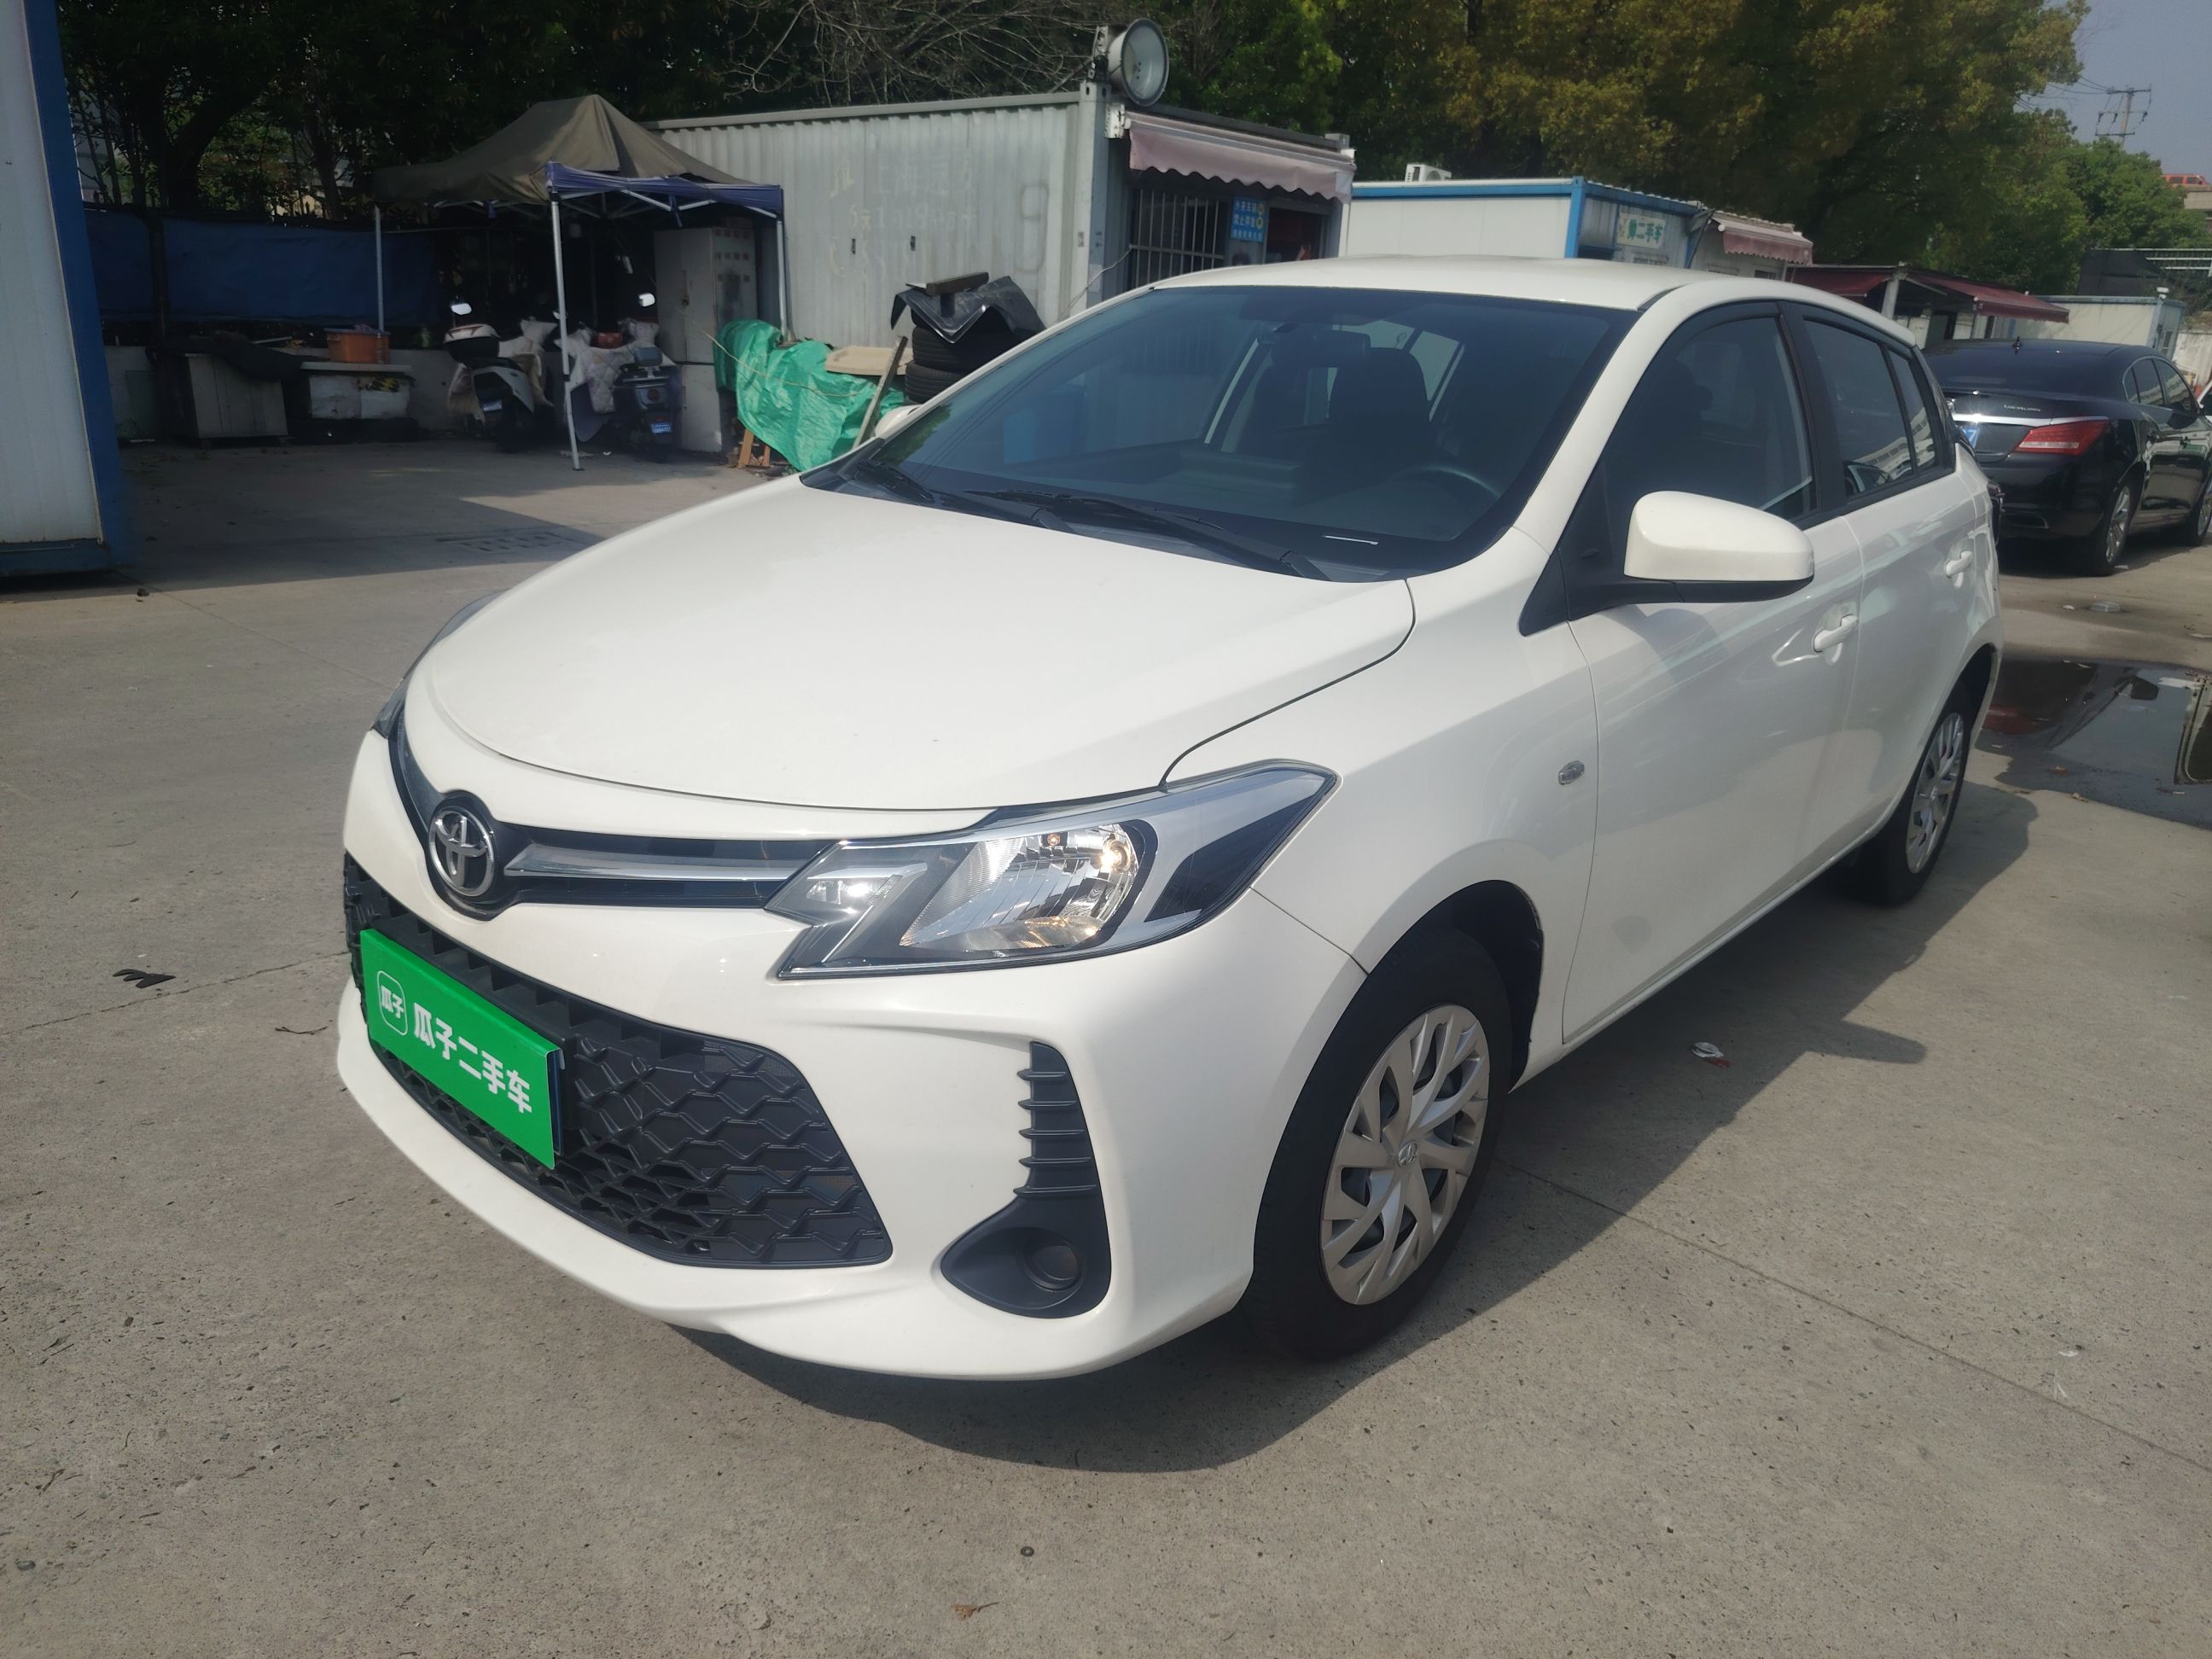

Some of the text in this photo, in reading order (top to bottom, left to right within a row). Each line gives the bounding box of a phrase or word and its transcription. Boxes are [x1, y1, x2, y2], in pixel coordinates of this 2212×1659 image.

[380, 985, 405, 1019] 瓜子
[413, 1002, 533, 1114] 瓜子二手车
